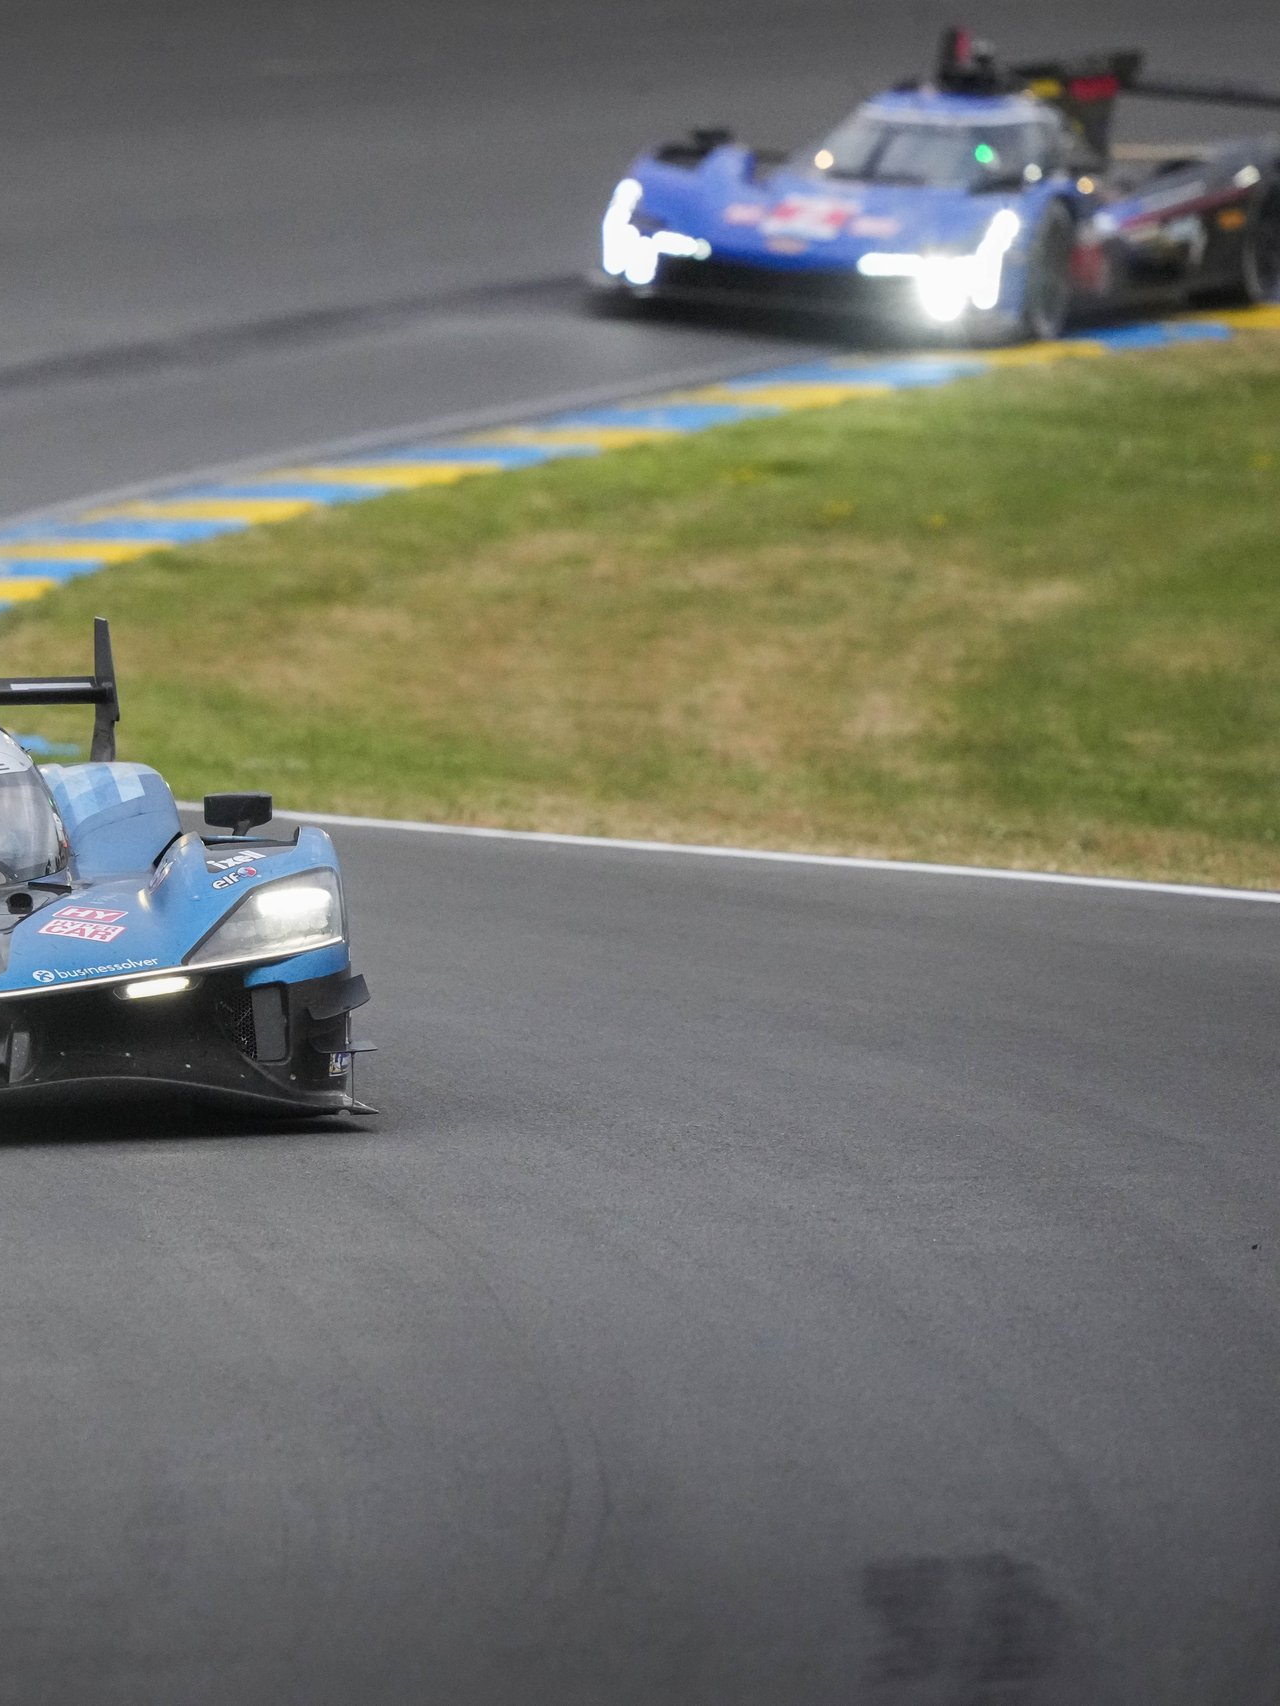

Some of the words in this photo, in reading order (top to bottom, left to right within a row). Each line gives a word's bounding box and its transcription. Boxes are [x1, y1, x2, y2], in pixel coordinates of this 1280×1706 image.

[206, 850, 266, 870] ixell
[212, 872, 240, 890] elf
[61, 908, 118, 920] HY
[44, 925, 113, 940] CAR
[52, 920, 120, 933] HYPER
[54, 958, 158, 979] businessolver
